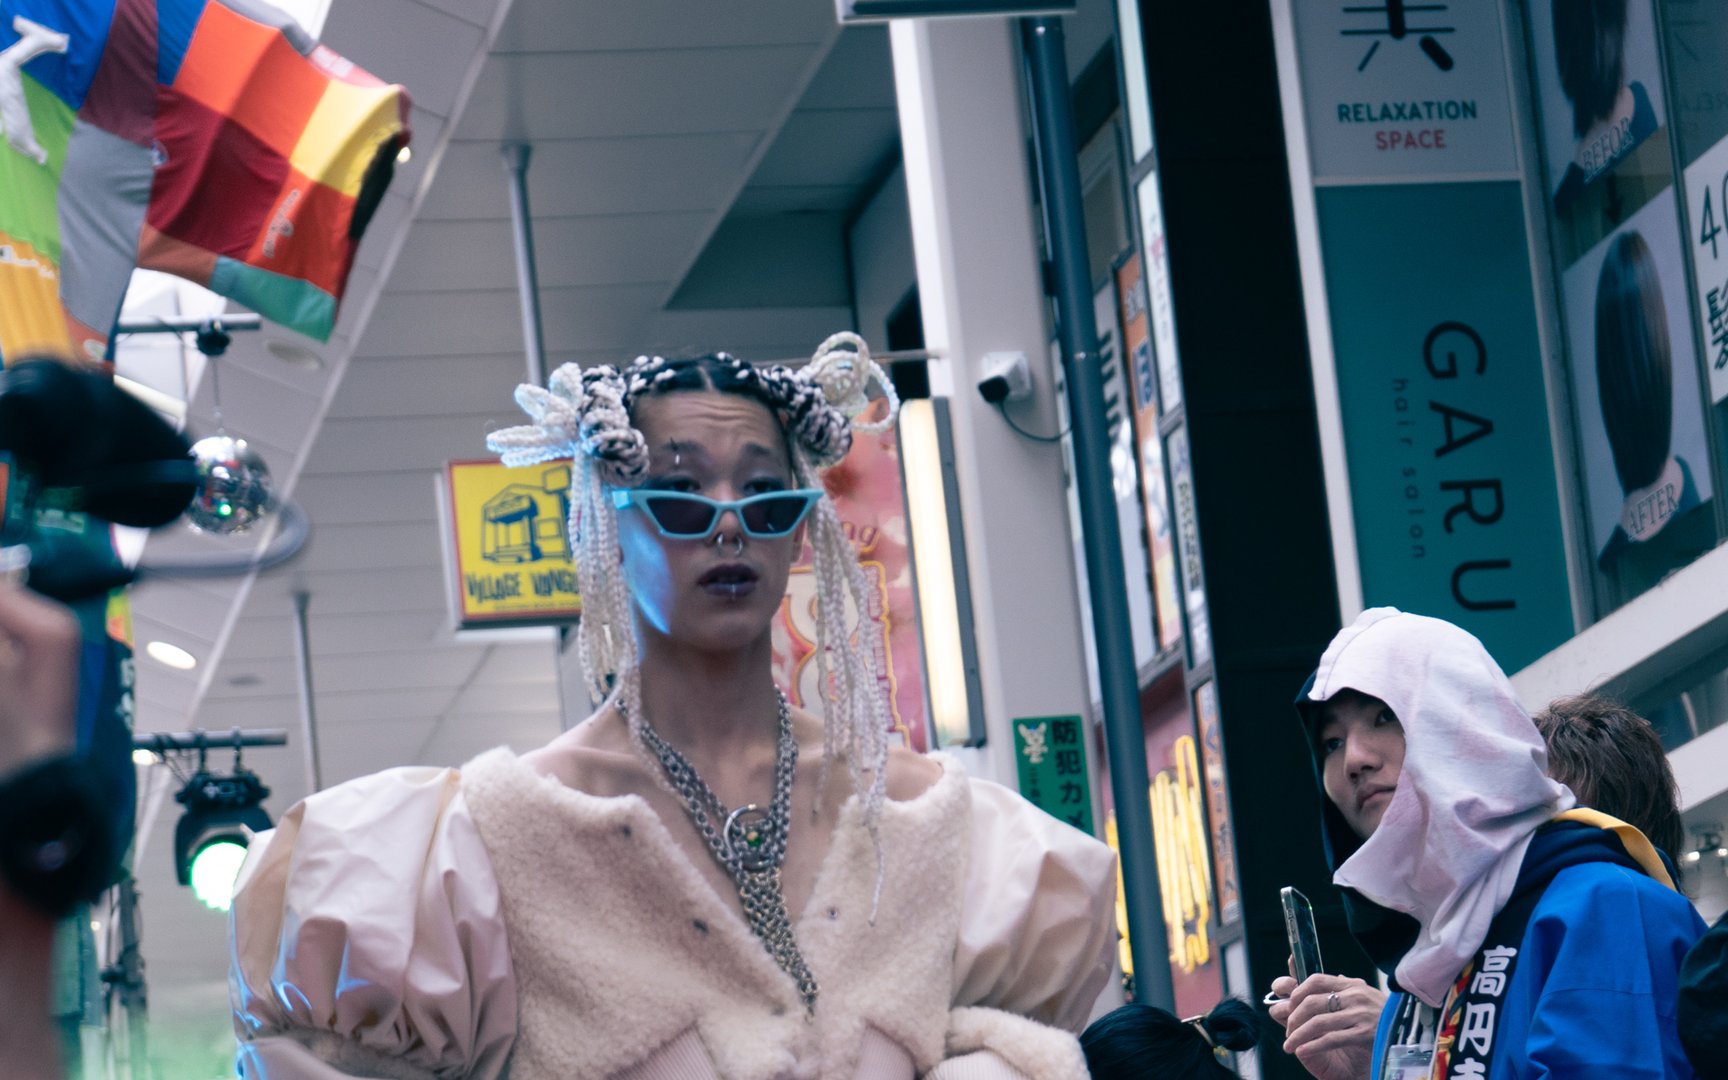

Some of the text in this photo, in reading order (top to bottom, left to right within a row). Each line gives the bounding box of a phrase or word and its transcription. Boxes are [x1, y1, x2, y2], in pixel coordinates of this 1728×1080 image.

[1337, 100, 1477, 123] RELAXATION
[1375, 129, 1447, 151] SPACE
[1393, 377, 1426, 559] hair salon
[1422, 320, 1517, 612] GARU
[1629, 483, 1679, 540] AFTER
[464, 572, 522, 603] VILLAGE
[1051, 719, 1086, 828] 防犯カメ
